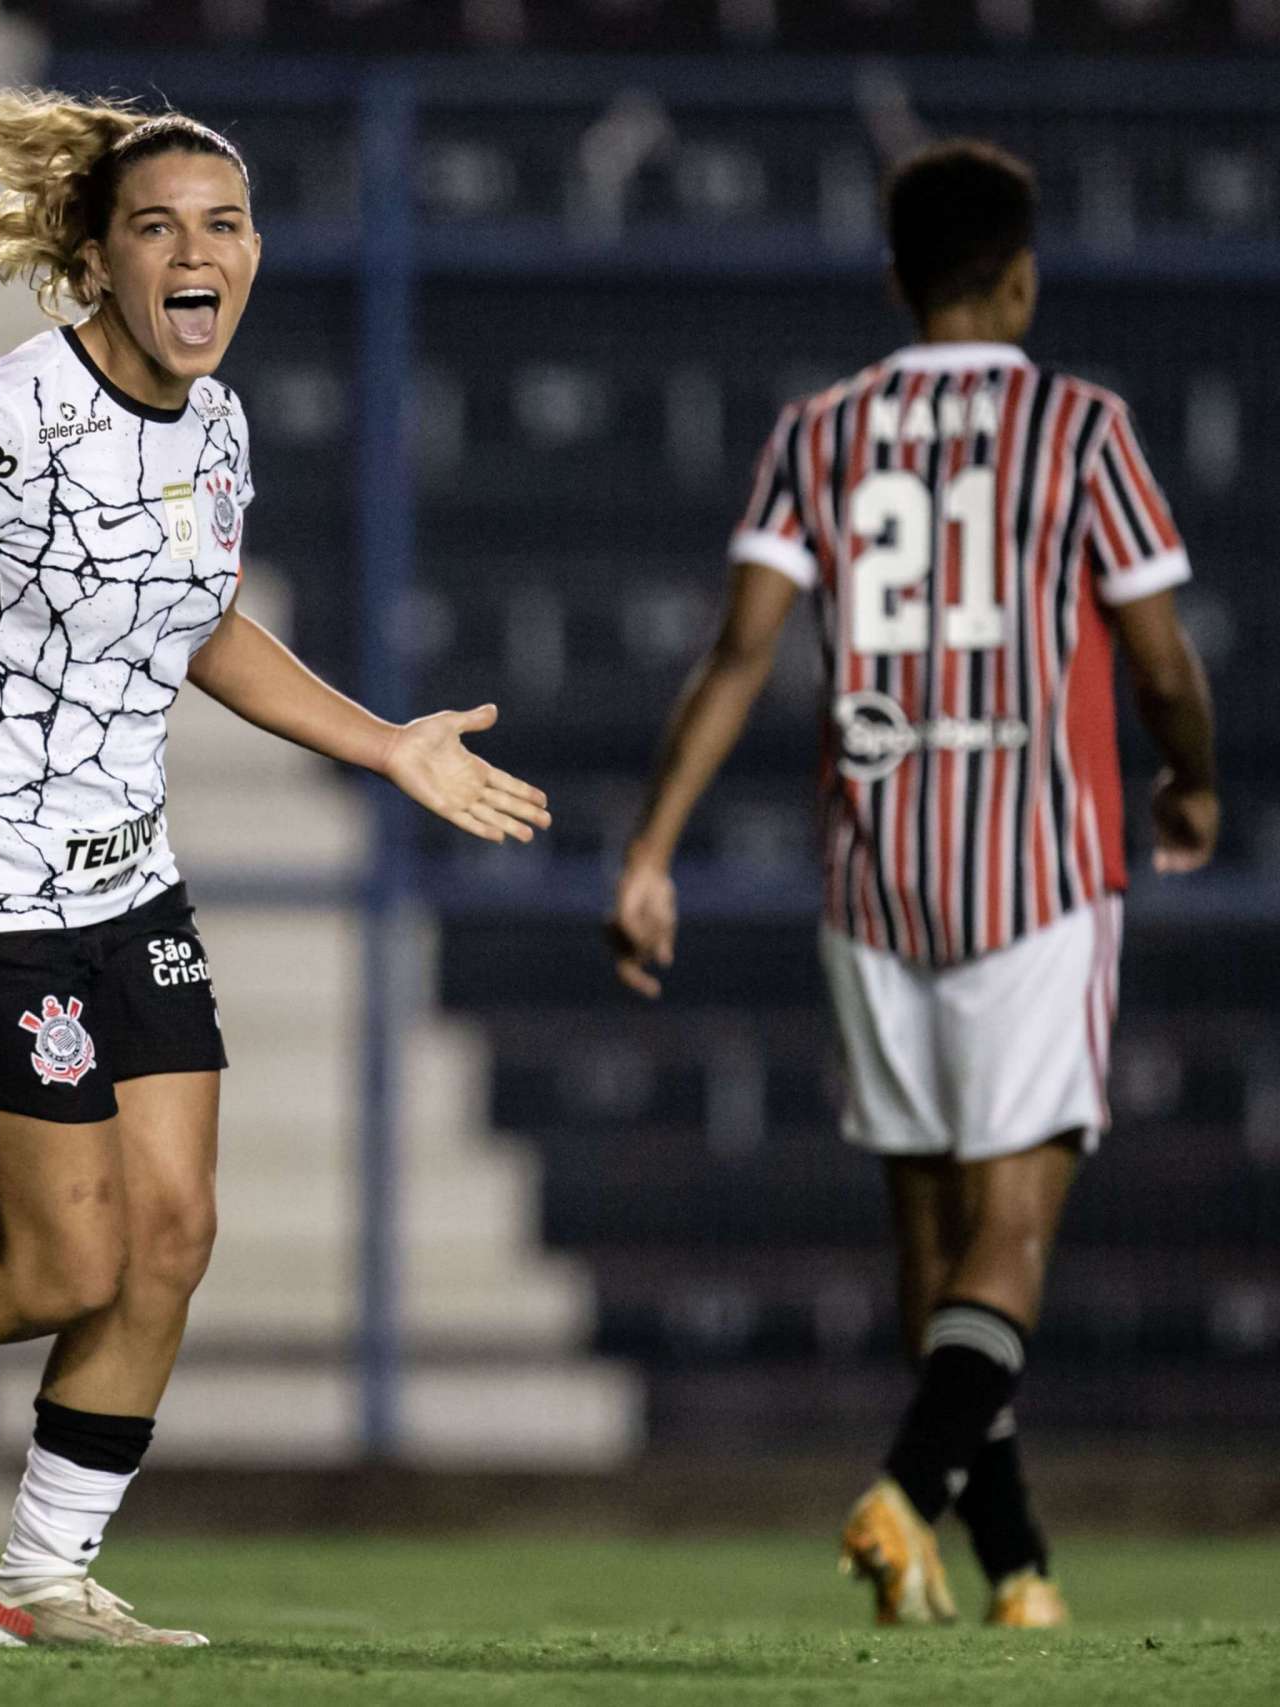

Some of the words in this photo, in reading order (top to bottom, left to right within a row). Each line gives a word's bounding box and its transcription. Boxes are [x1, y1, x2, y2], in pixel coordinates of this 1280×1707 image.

[38, 415, 113, 444] galera.bet
[850, 466, 1005, 656] 21
[147, 937, 192, 964] São
